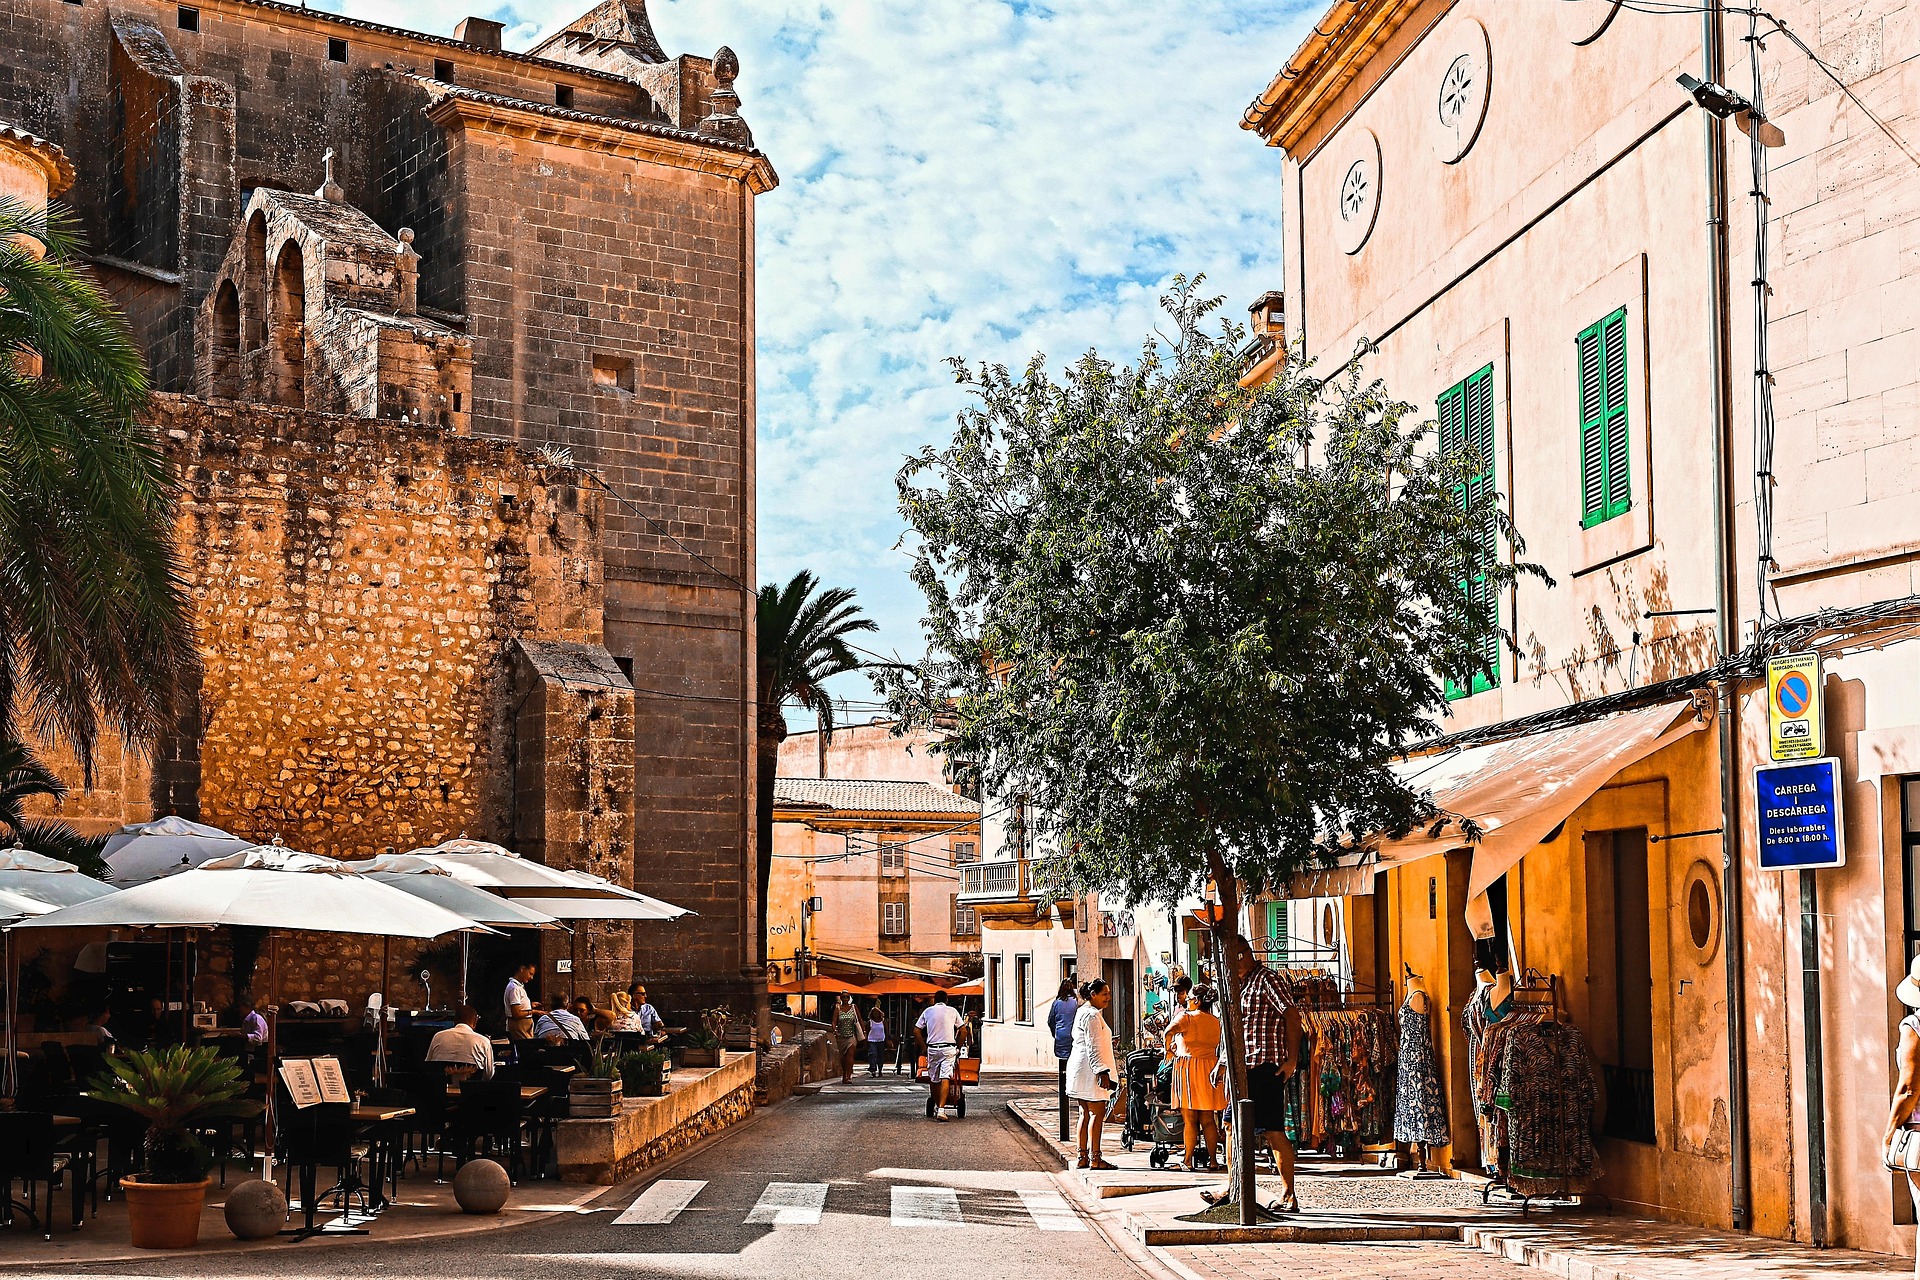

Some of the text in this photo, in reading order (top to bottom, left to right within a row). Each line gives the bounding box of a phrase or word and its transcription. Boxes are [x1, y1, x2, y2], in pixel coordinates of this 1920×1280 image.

[1774, 783, 1816, 796] CÀRREGA
[1794, 796, 1798, 804] I
[1766, 804, 1826, 818] DESCÀRREGA
[1786, 824, 1826, 834] laborables
[1802, 834, 1820, 842] 18:00
